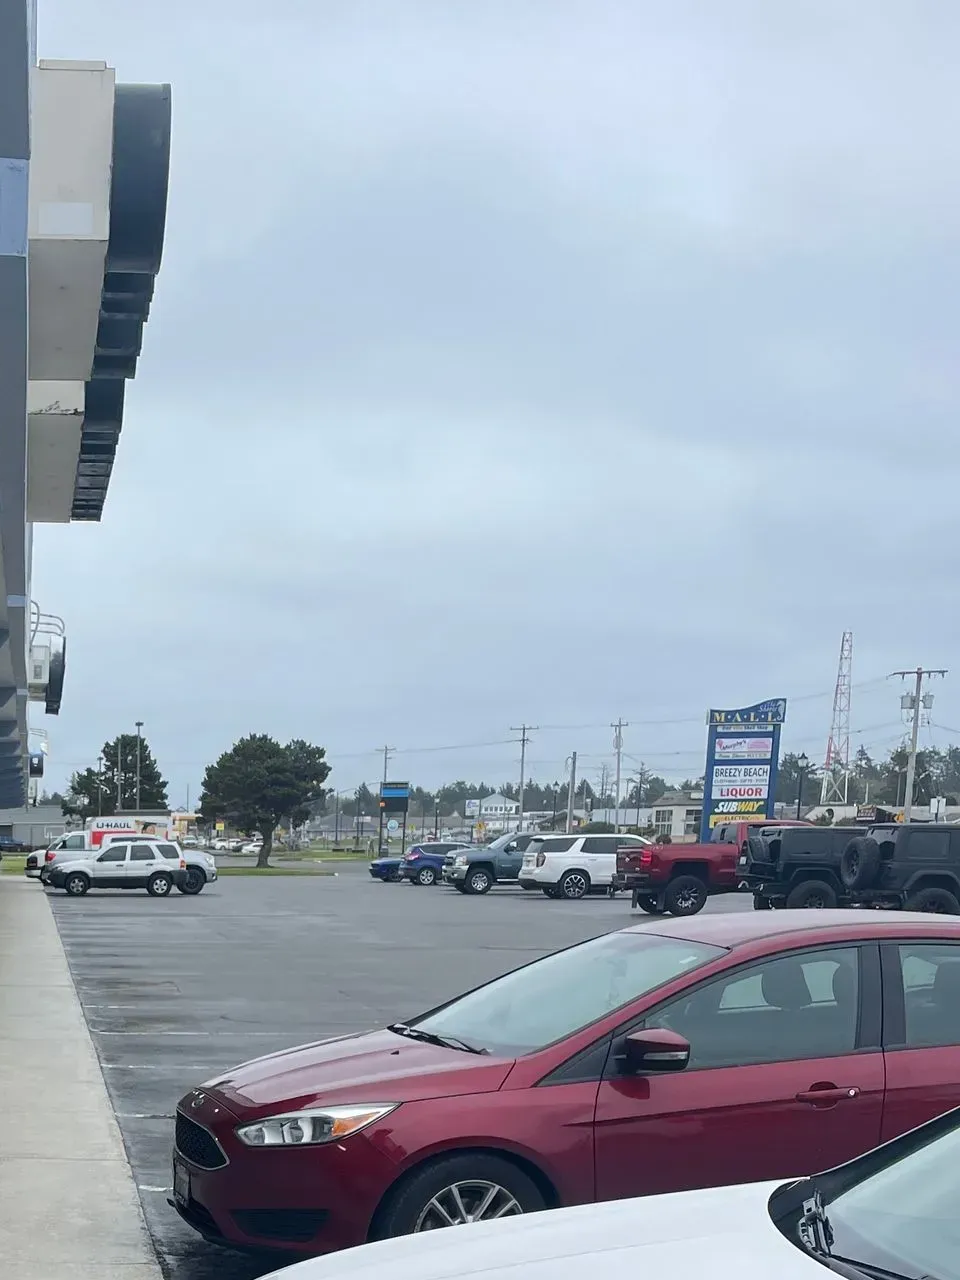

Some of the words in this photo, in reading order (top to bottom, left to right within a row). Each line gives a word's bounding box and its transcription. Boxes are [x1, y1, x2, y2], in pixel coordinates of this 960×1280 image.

[715, 767, 742, 777] BREEZY
[744, 767, 768, 777] BEACH
[720, 788, 762, 797] LIQUOR
[714, 801, 764, 812] SUBWAY
